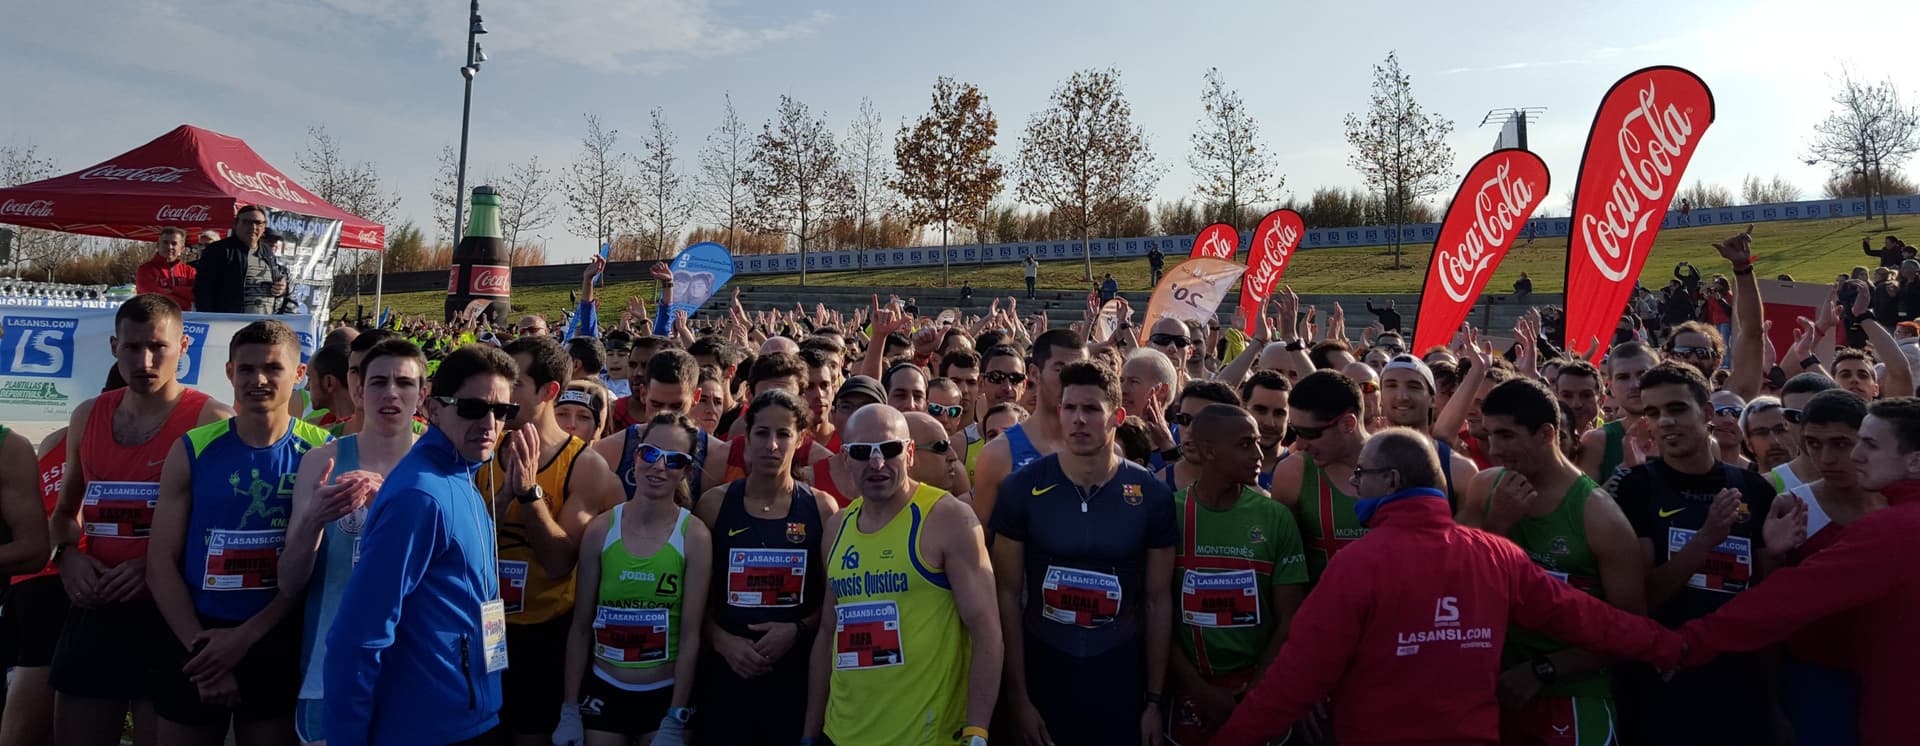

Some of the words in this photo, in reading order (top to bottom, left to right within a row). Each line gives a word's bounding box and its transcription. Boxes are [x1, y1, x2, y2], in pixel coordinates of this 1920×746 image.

[1583, 79, 1692, 281] Coca-Cola
[156, 204, 211, 221] Coca-Cola
[1438, 157, 1532, 303] Coca-Cola
[1247, 216, 1297, 302] Coca-Cola
[8, 318, 75, 328] LASANSI.COM
[865, 569, 908, 597] Quística
[1062, 574, 1117, 586] LASANSI.COM
[1197, 576, 1253, 585] LASANSI.COM
[608, 614, 665, 622] LASANSI.COM
[1398, 627, 1492, 644] LASANSI.COM
